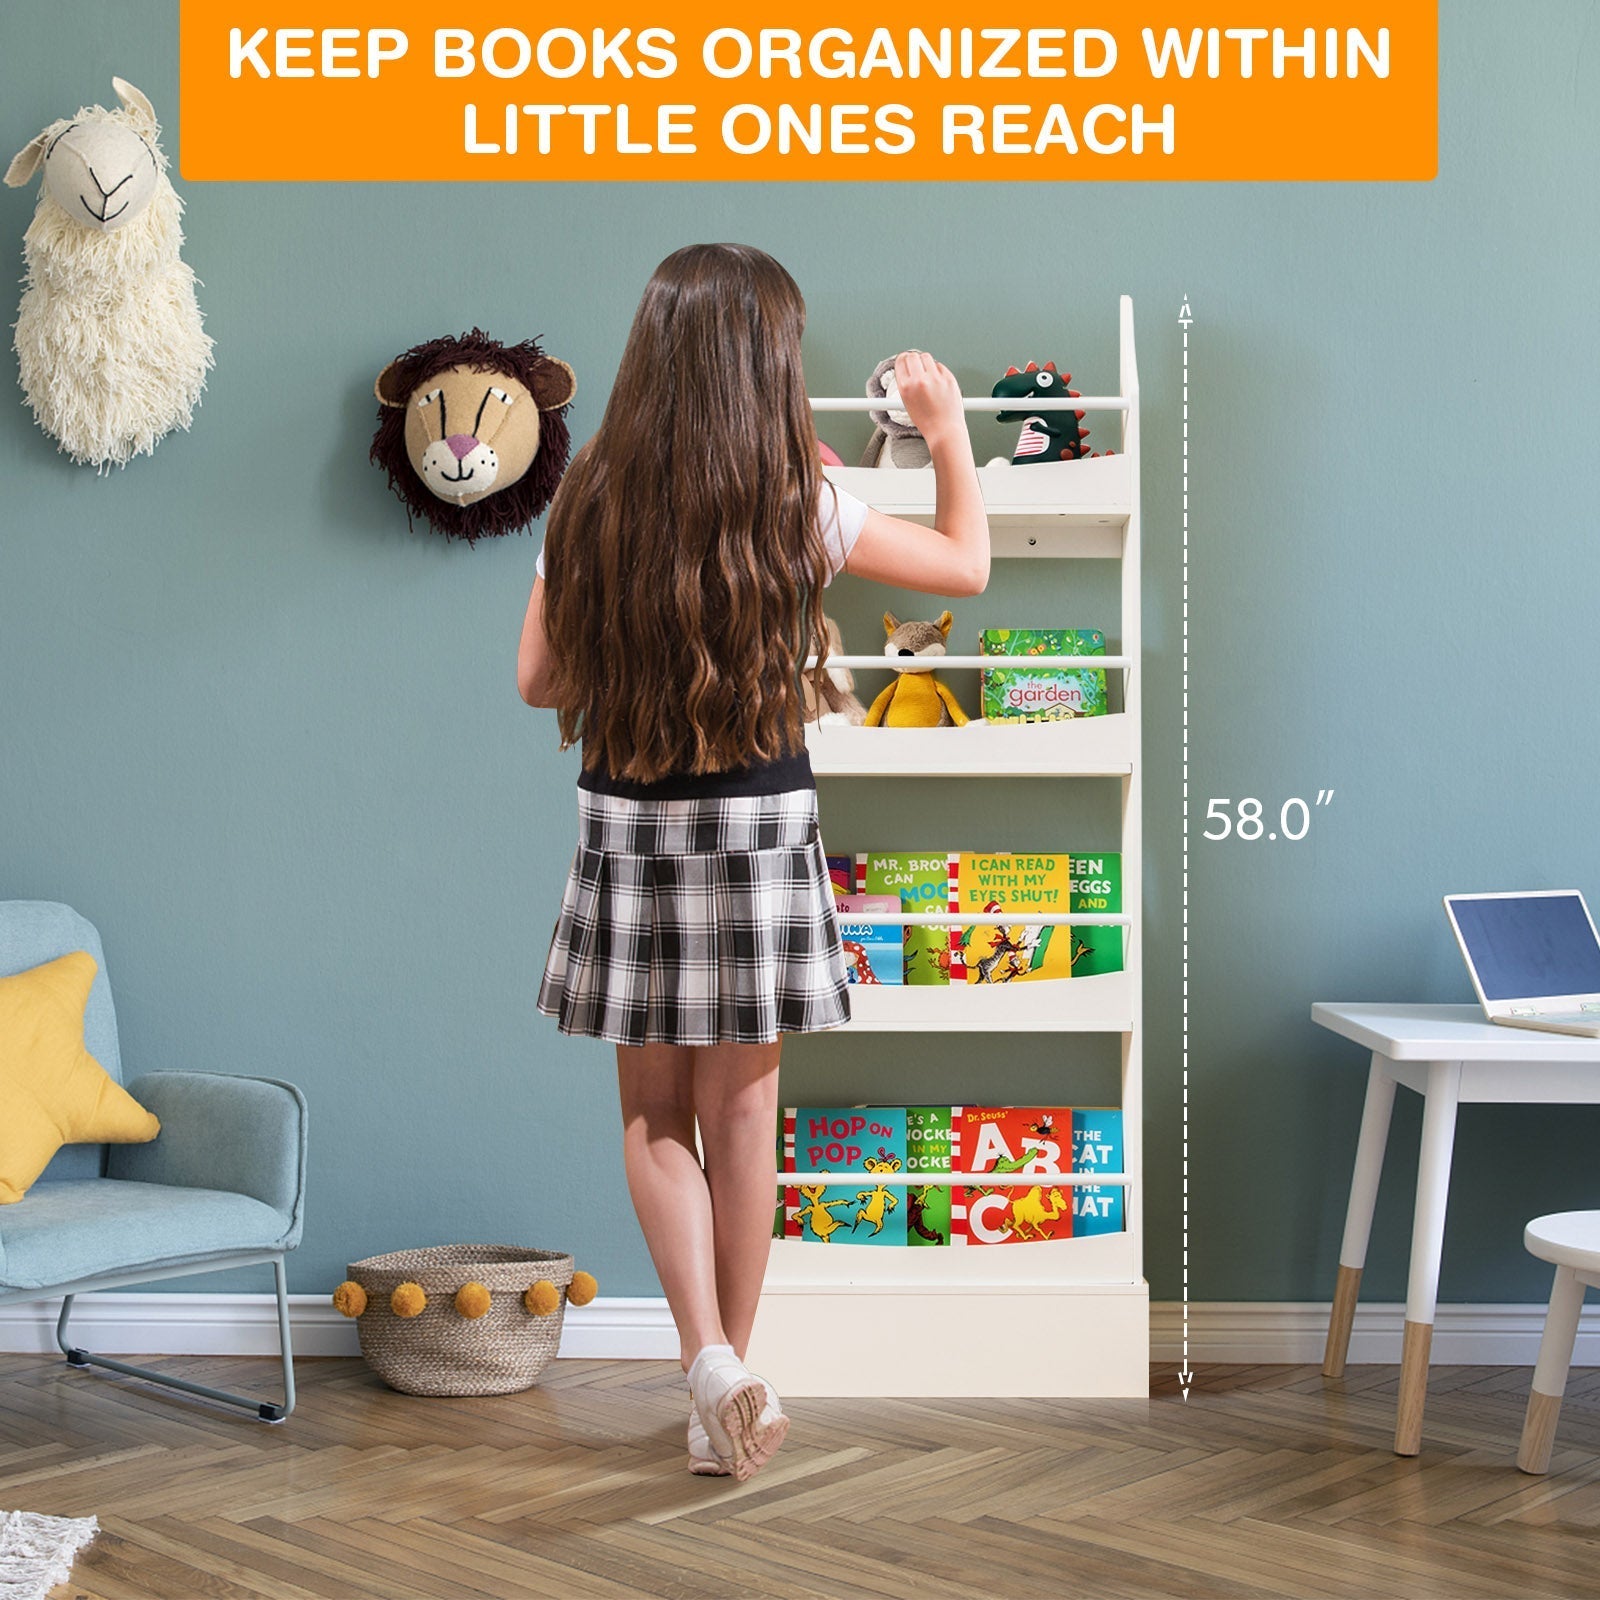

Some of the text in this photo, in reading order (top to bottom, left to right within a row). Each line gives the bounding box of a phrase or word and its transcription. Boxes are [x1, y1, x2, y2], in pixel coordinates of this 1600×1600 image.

[1027, 680, 1042, 690] the
[1009, 684, 1081, 706] garden
[873, 858, 903, 872] MR.
[971, 858, 1055, 871] I CAN READ
[884, 873, 914, 886] CAN
[978, 874, 1047, 887] WITH MY
[1069, 880, 1112, 894] EGGS
[969, 889, 1059, 903] EYES SHUT!
[1078, 898, 1107, 909] AND
[930, 1113, 939, 1124] A
[967, 1113, 980, 1122] Dr.
[808, 1116, 893, 1140] HOP ON
[1074, 1130, 1102, 1141] THE
[806, 1142, 862, 1168] POP
[912, 1145, 947, 1154] IN MY
[907, 1156, 951, 1169] OCKE
